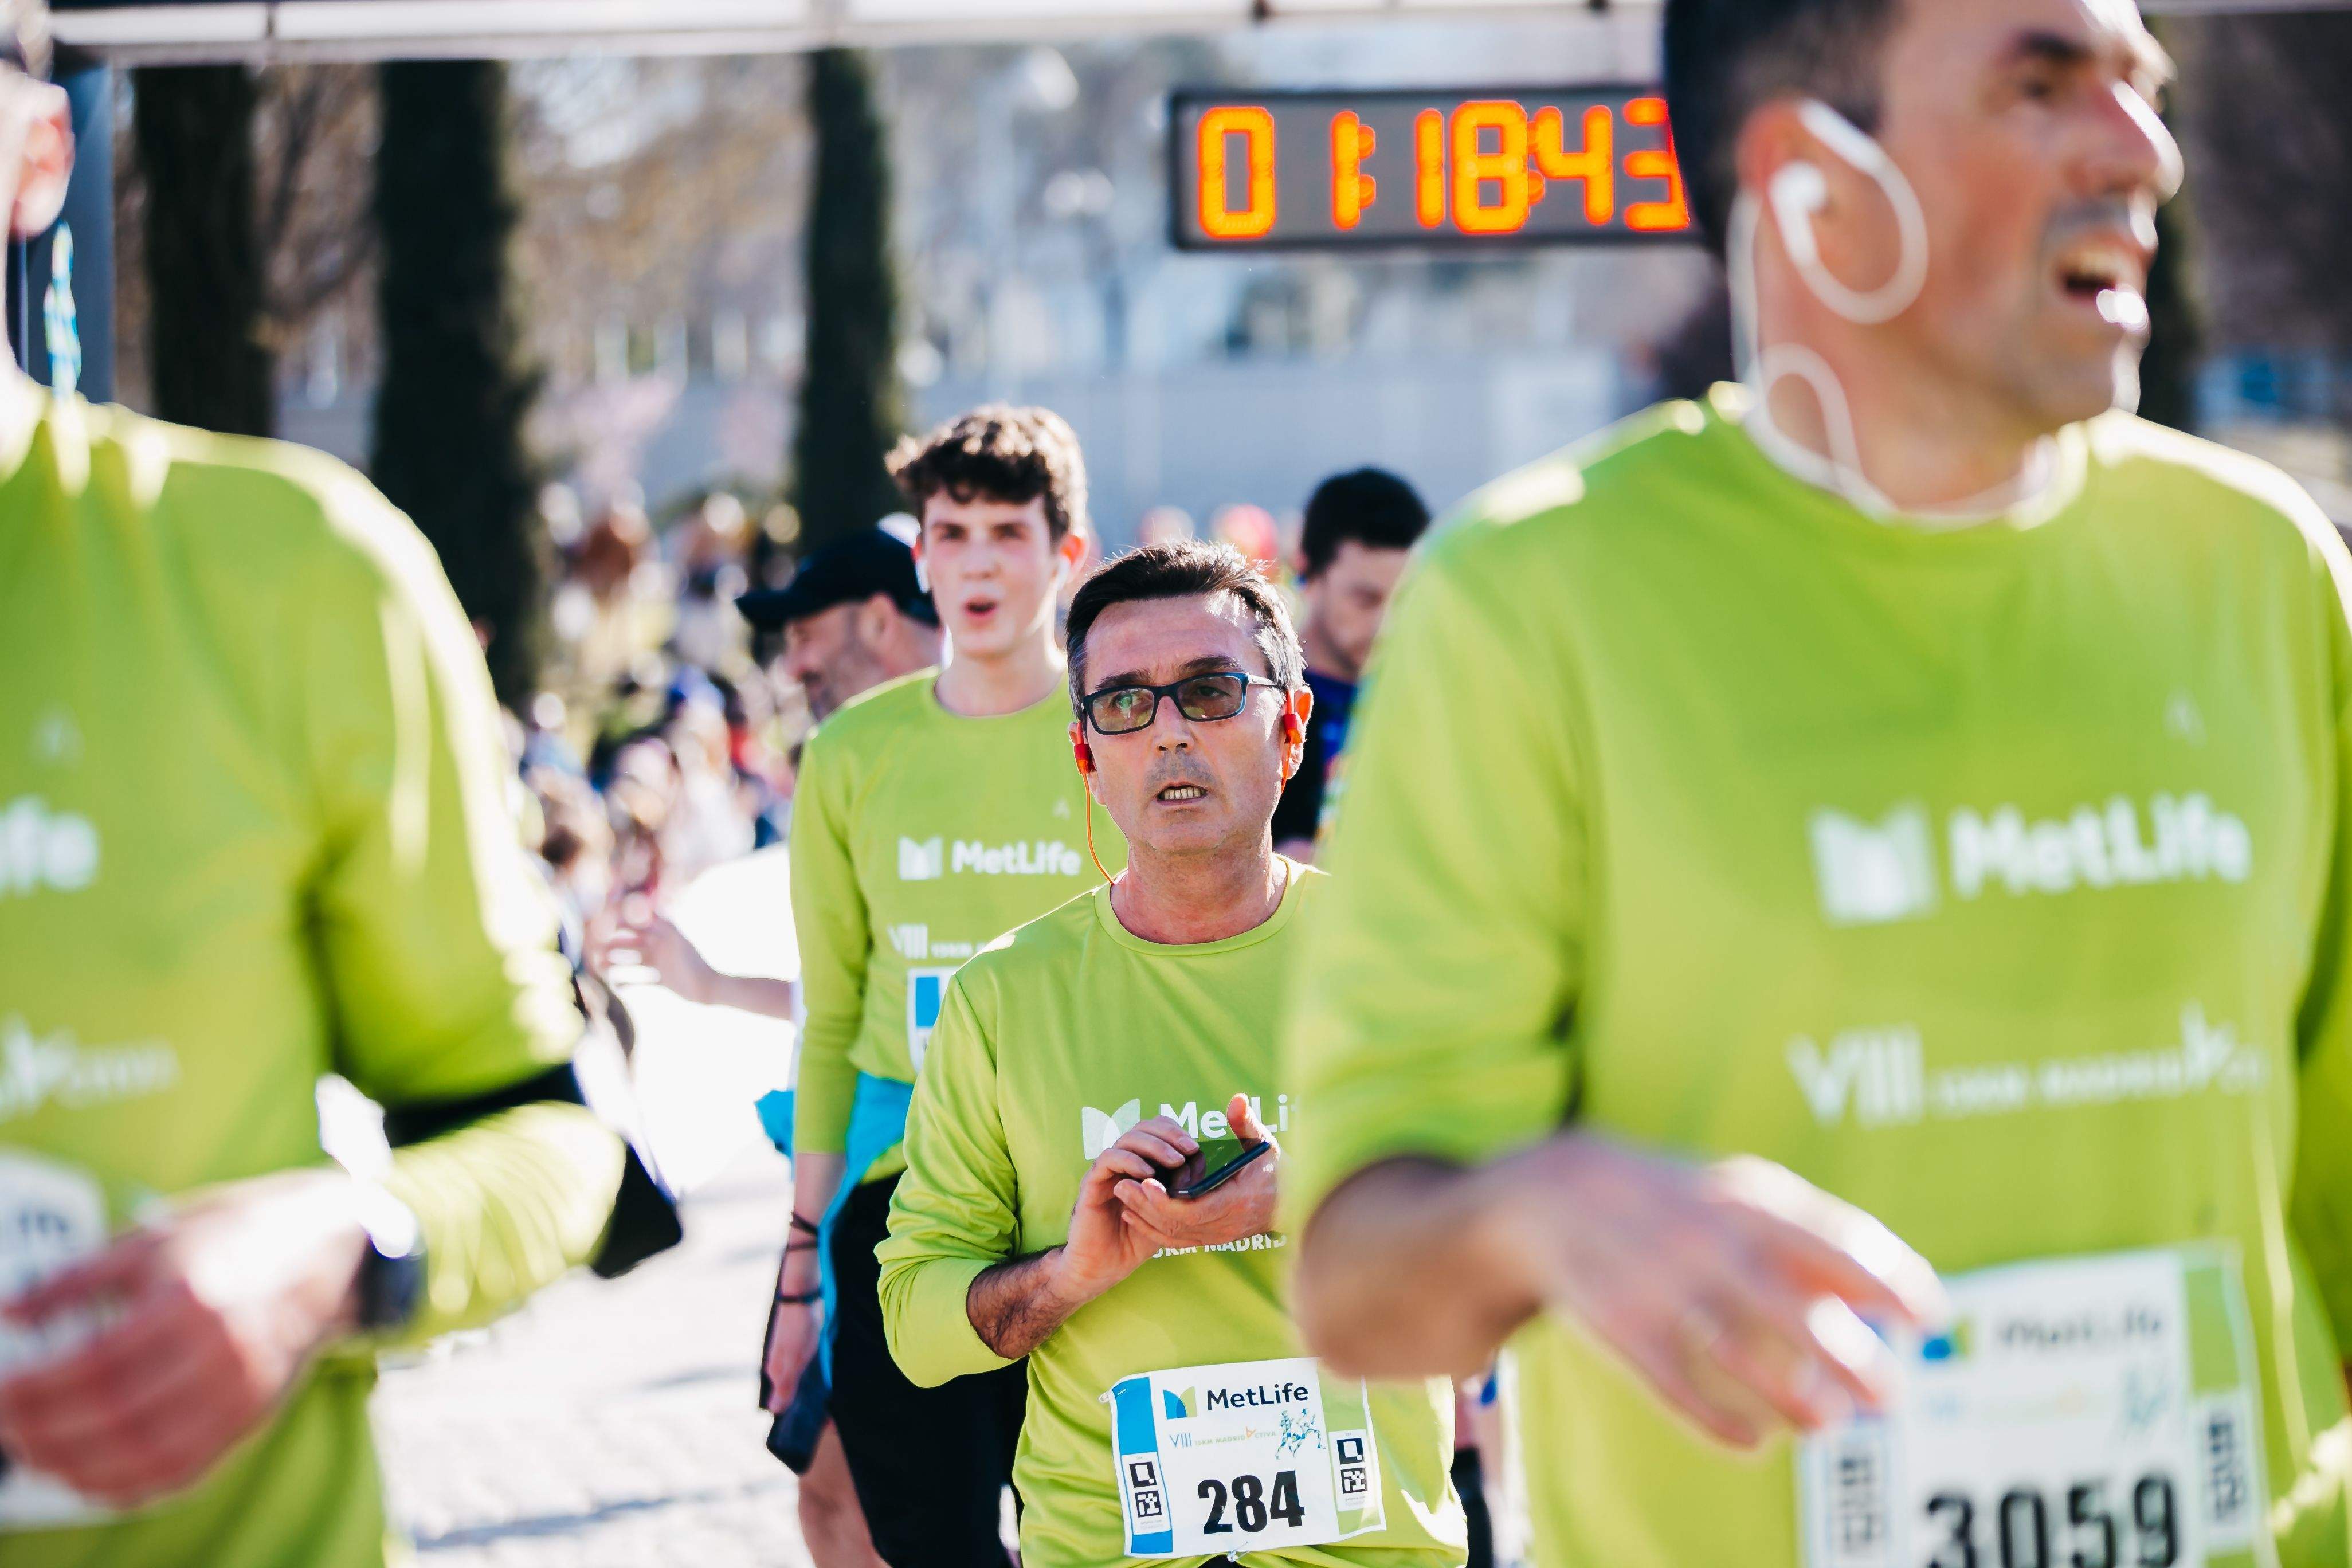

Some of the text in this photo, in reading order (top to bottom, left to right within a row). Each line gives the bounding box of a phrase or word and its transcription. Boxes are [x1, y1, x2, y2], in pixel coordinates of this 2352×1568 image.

[952, 840, 1081, 875] MetLife
[1949, 789, 2251, 897] MetLife
[1786, 1024, 1925, 1127] VIII
[1206, 1382, 1309, 1410] MetLife
[1169, 1432, 1192, 1448] VIII
[1216, 1435, 1245, 1444] MADRID
[1197, 1470, 1305, 1535] 284
[1926, 1472, 2181, 1568] 3059
